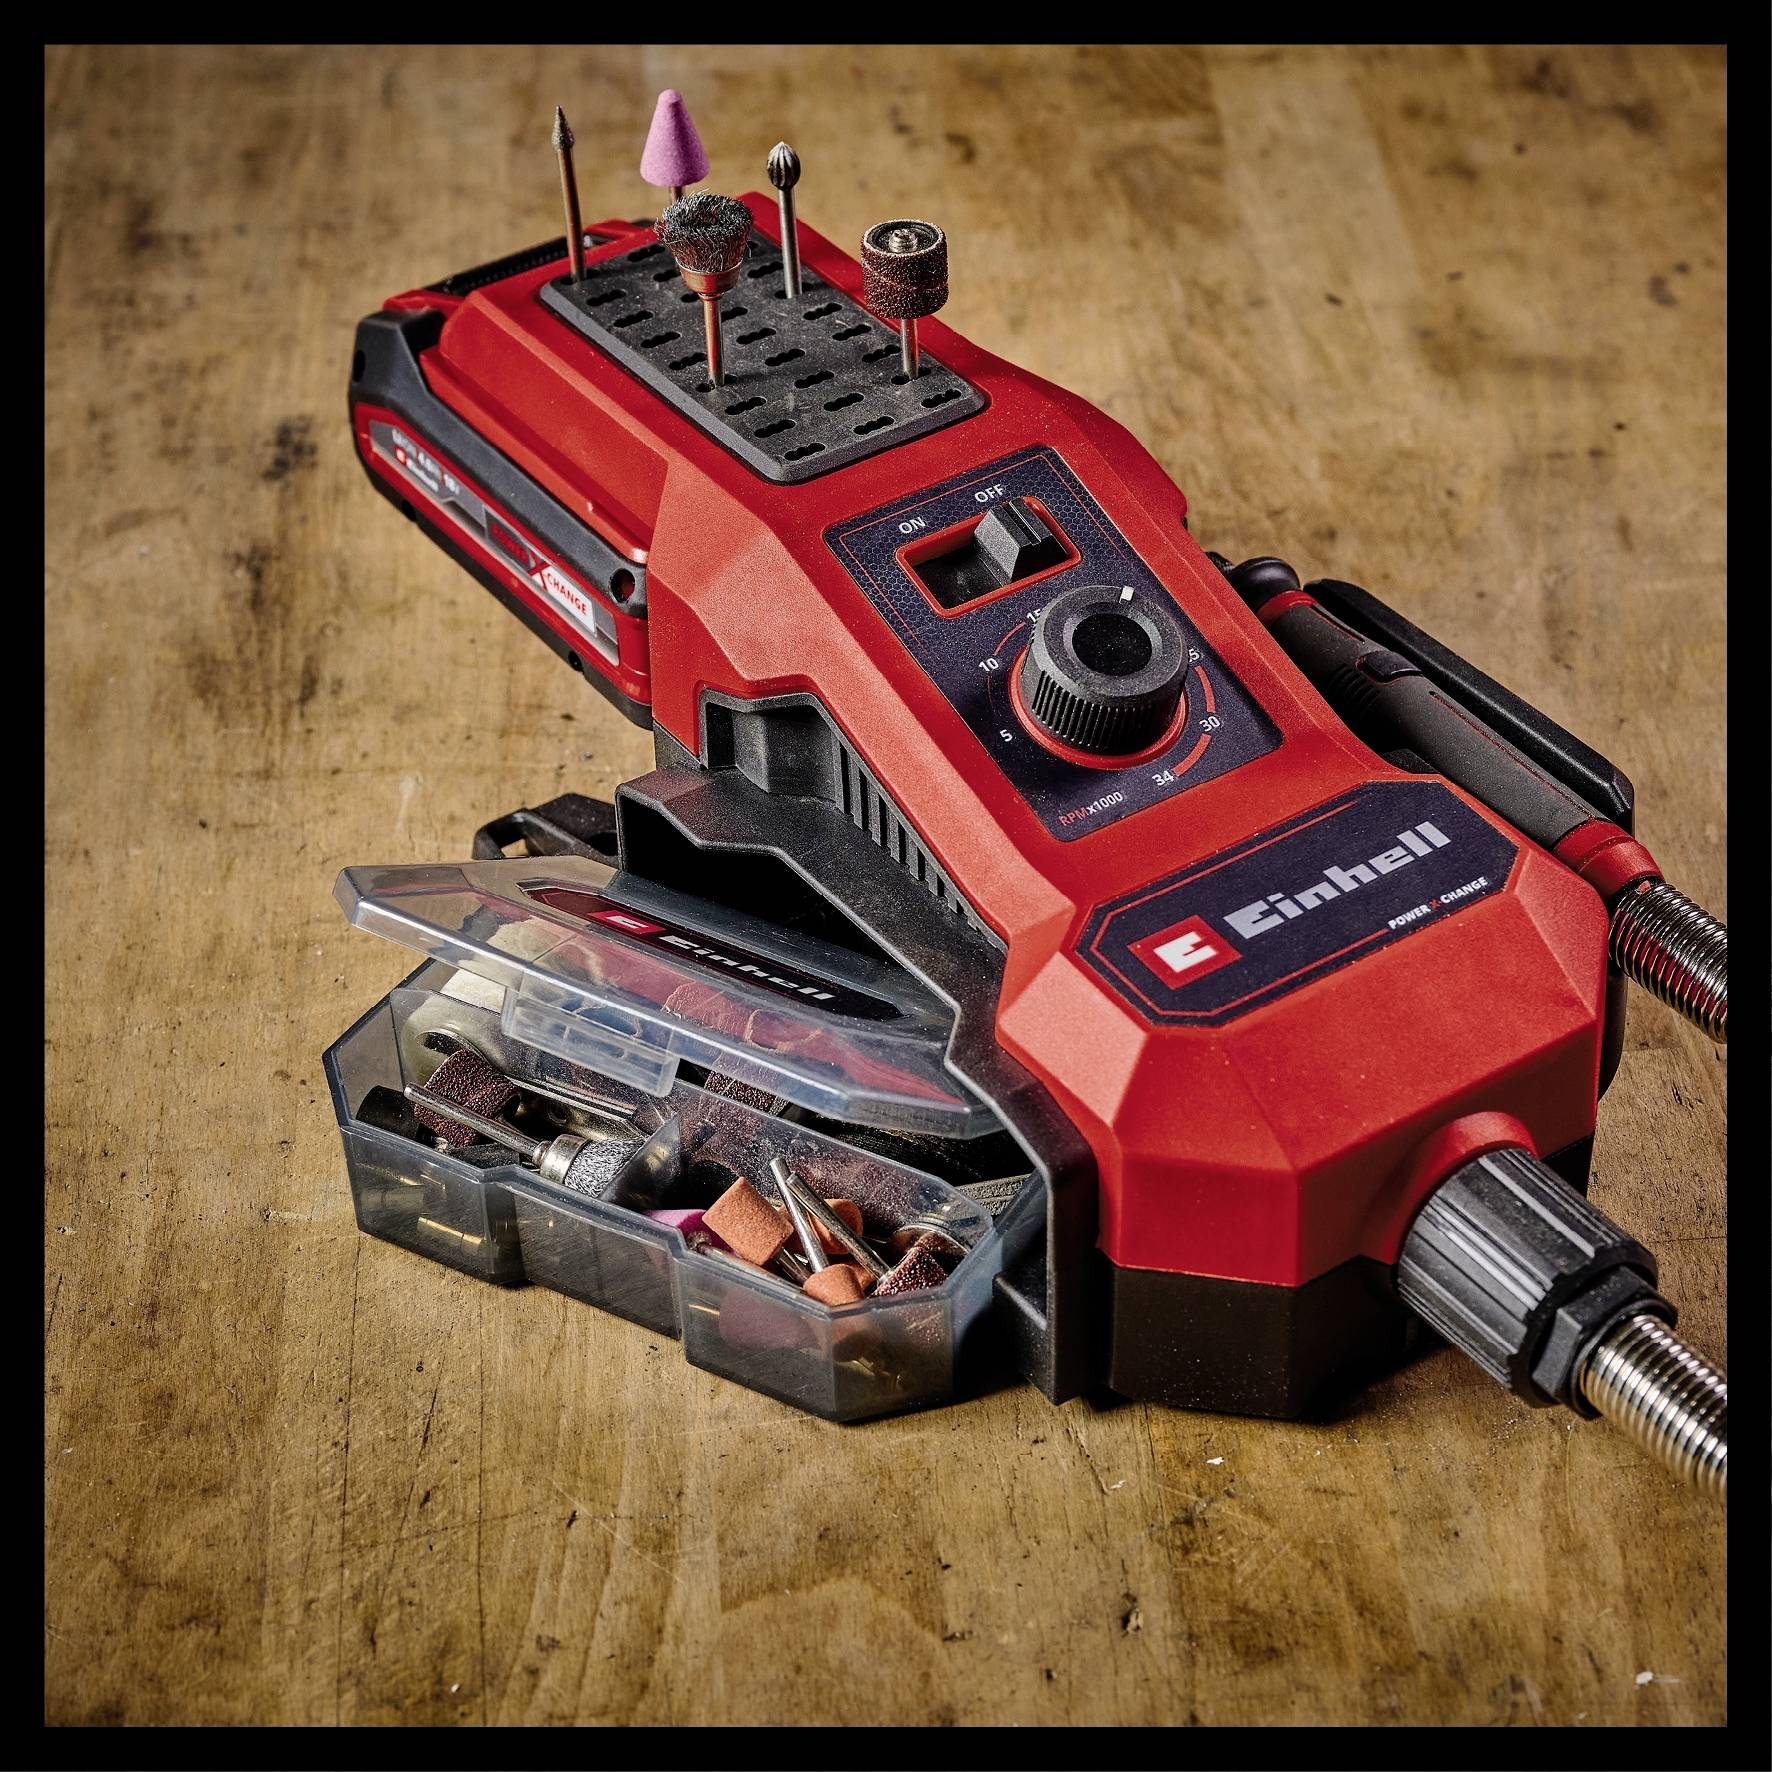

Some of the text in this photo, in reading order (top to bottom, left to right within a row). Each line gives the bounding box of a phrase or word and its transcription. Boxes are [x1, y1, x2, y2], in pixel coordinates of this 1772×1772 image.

[974, 483, 1005, 503] OFF
[898, 516, 926, 534] ON
[1188, 648, 1201, 662] 5
[978, 657, 999, 672] 10
[1199, 715, 1221, 732] 30
[1000, 729, 1013, 742] 5
[1152, 770, 1175, 786] 34
[1223, 821, 1451, 940] Einhell
[1387, 904, 1432, 930] POWER
[658, 935, 836, 1000] Einhell
